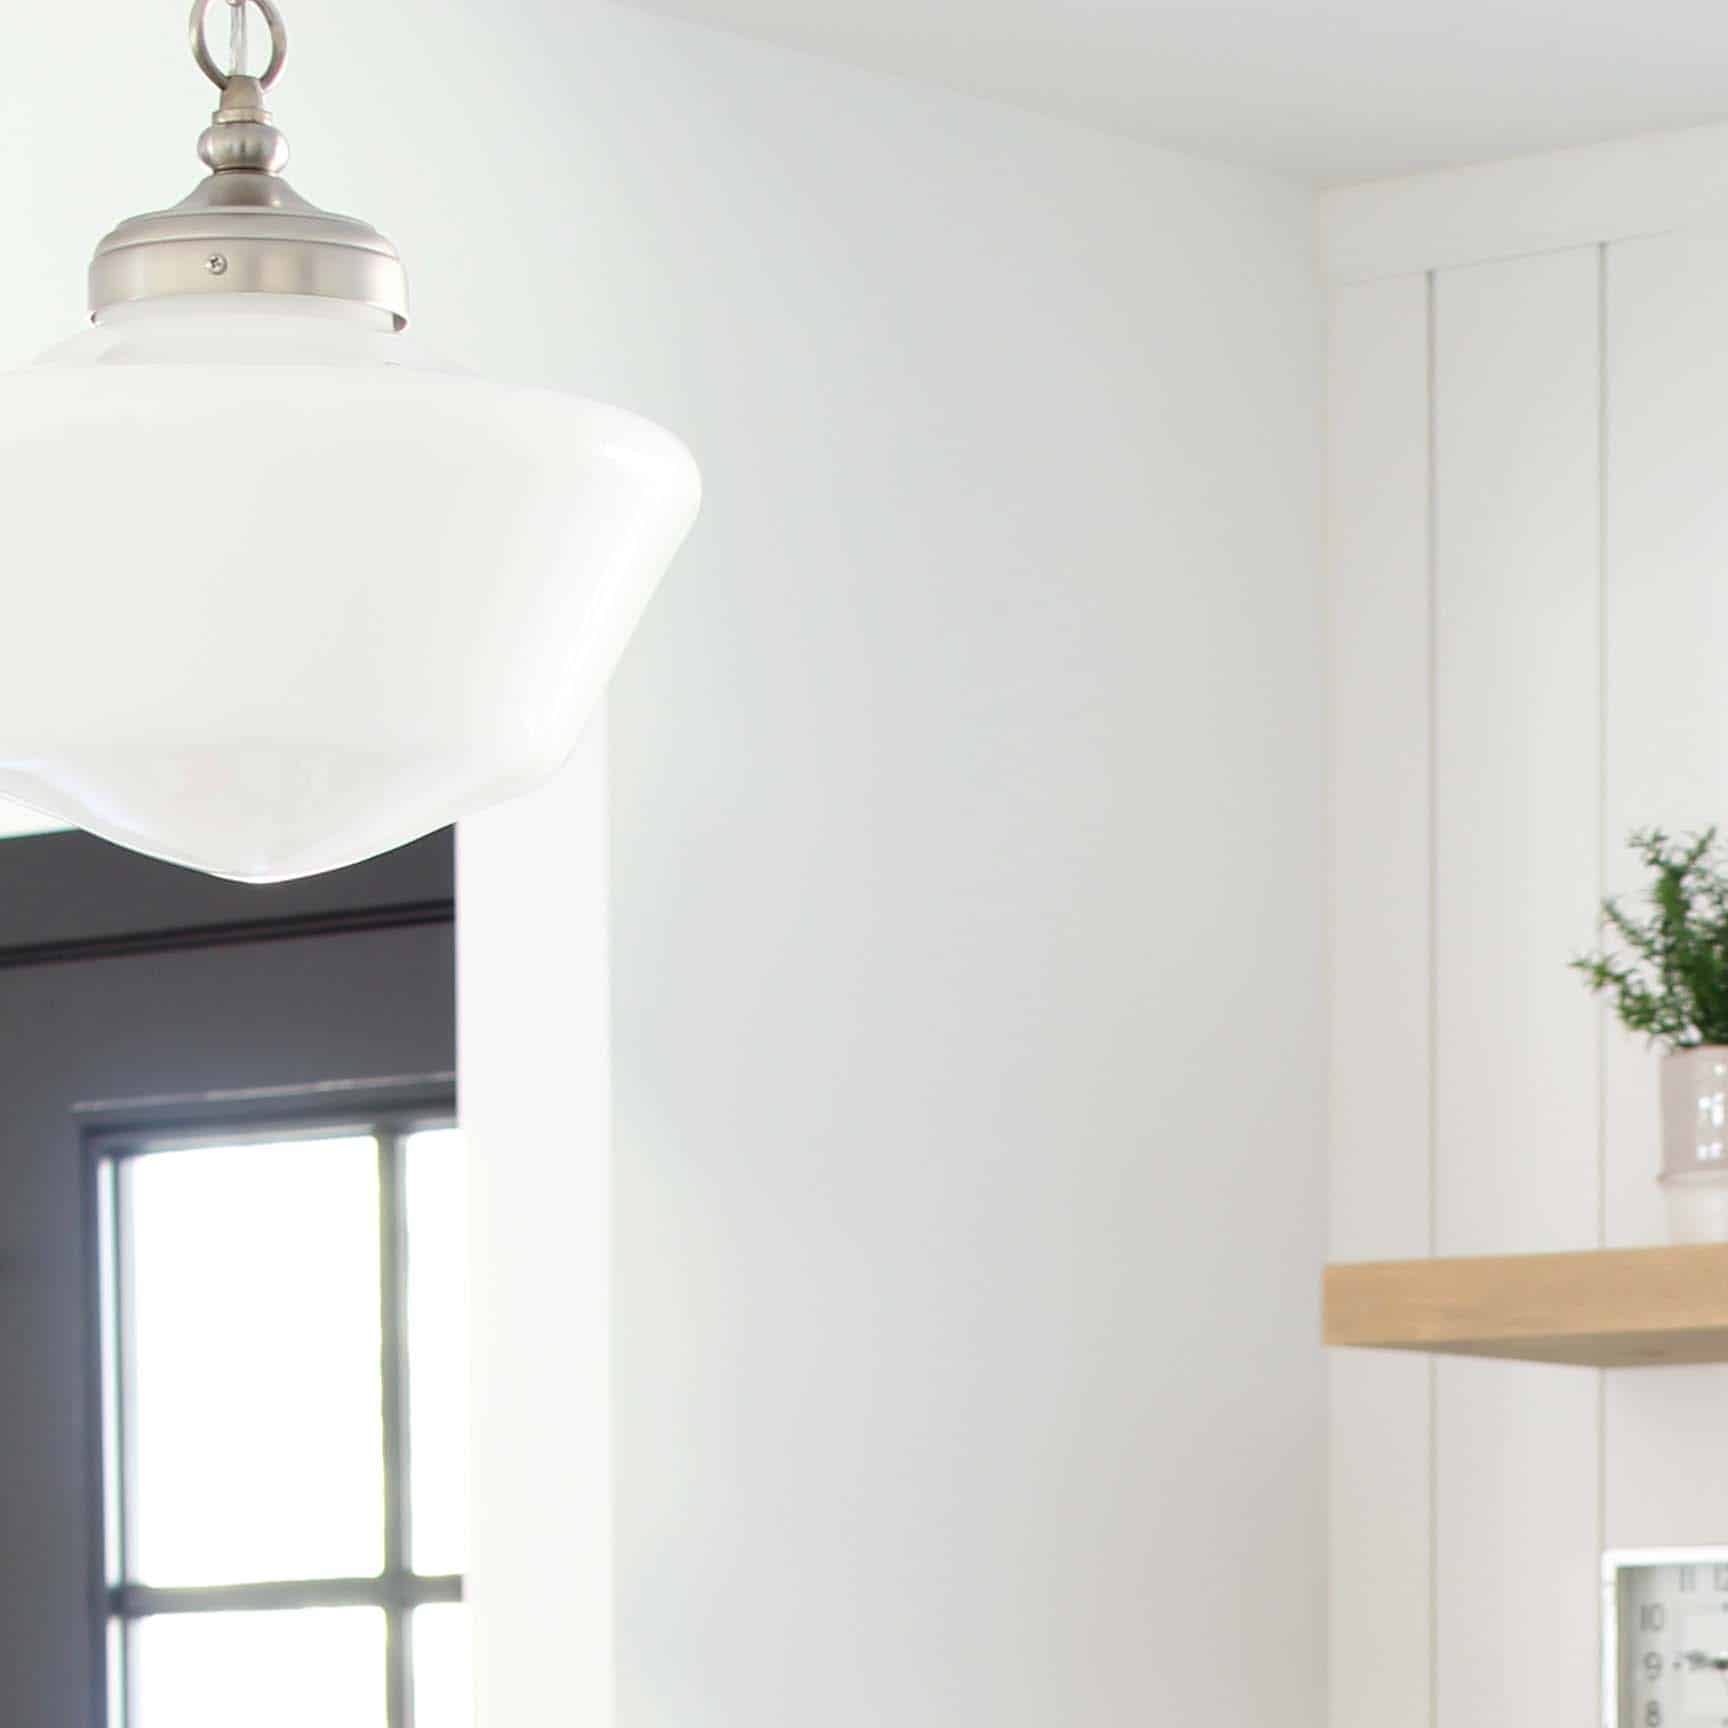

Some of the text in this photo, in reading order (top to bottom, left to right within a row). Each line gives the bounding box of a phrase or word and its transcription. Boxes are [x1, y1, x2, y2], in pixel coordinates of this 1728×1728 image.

[1640, 1602, 1665, 1631] 10
[1643, 1652, 1662, 1680] 9
[1645, 1700, 1661, 1728] 8
